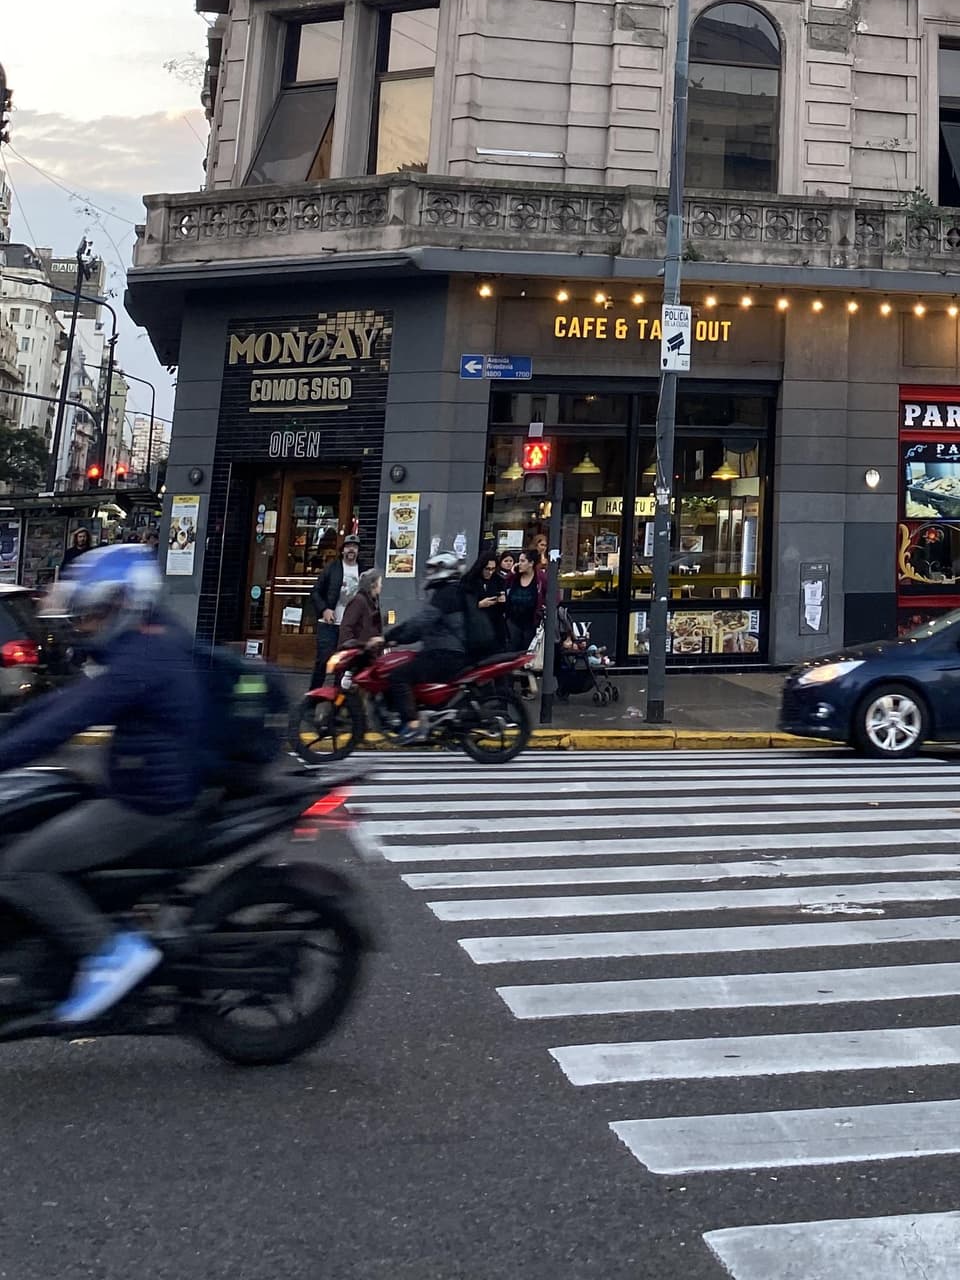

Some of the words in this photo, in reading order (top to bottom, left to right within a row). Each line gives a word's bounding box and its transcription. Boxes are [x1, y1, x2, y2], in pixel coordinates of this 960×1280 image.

[554, 316, 607, 339] CAFE
[615, 318, 628, 339] &
[696, 320, 732, 342] OUT
[228, 326, 377, 365] MONDAY
[269, 431, 321, 458] OPEN
